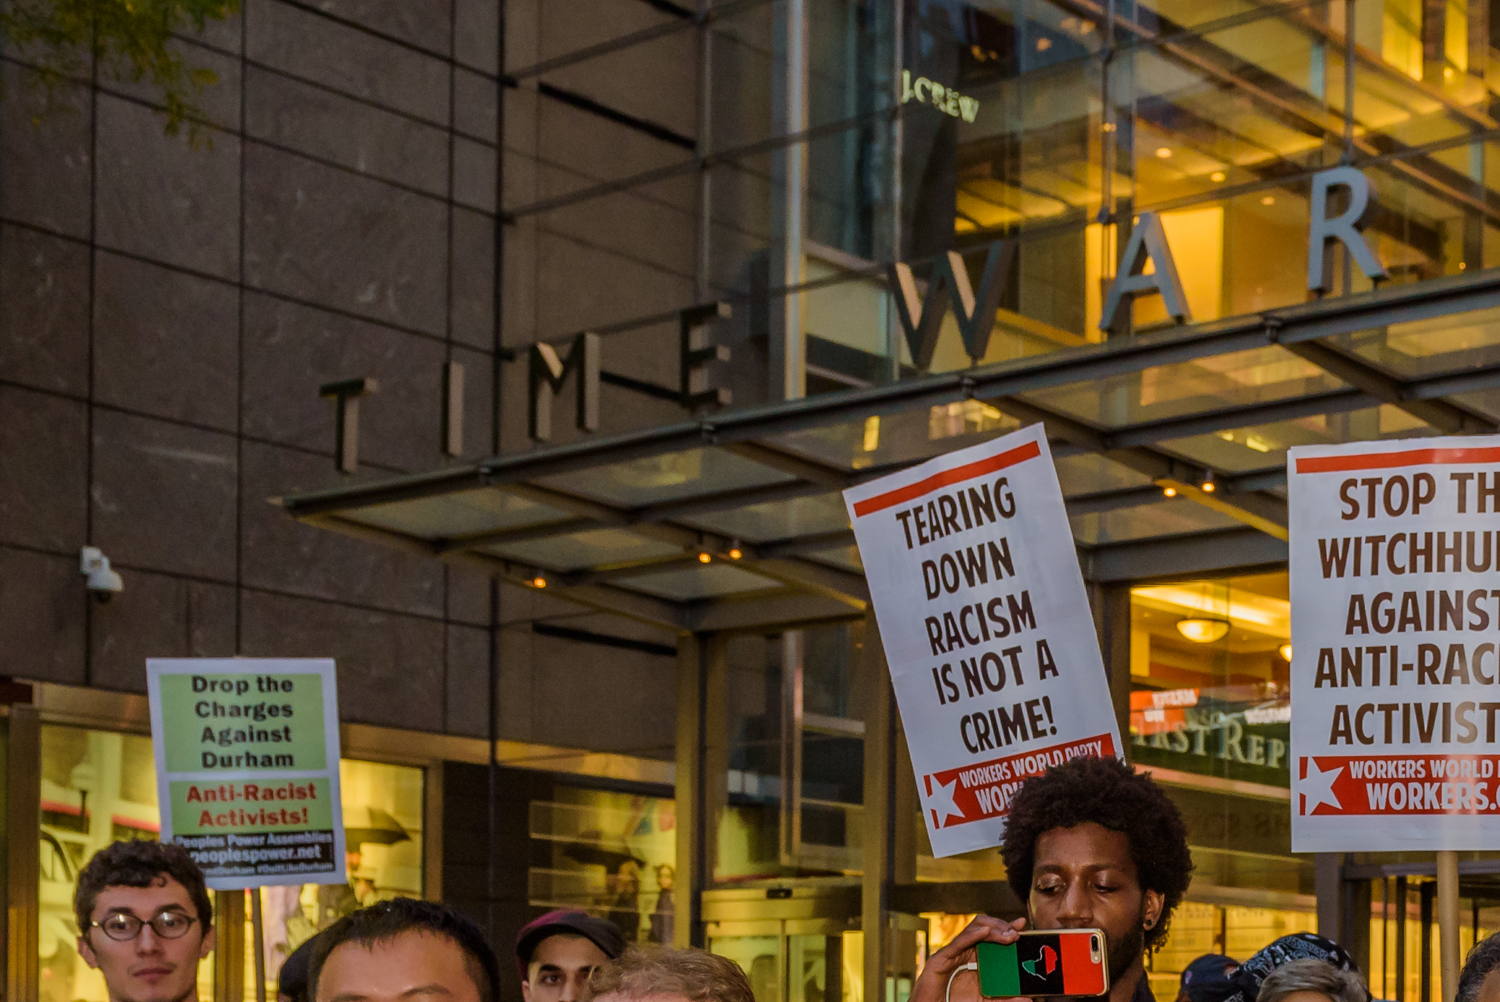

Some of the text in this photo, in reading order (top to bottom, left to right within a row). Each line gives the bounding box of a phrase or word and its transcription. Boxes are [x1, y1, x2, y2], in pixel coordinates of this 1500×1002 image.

[320, 301, 732, 475] TIME
[1339, 472, 1436, 520] STOP
[896, 477, 1016, 550] TEARING
[922, 537, 1015, 600] DOWN
[924, 590, 1037, 656] RACISM
[192, 676, 293, 695] Drop the
[931, 639, 1058, 704] IS NOT A
[195, 701, 293, 721] Charges
[960, 696, 1057, 754] CRIME!
[201, 725, 292, 747] Against
[202, 751, 294, 768] Durham
[959, 762, 1011, 788] WORKERS
[1011, 750, 1063, 777] WORLD
[1350, 759, 1426, 780] WORKERS
[1430, 759, 1494, 779] WORLD
[186, 782, 317, 803] Anti-Racist
[199, 808, 308, 827] Activists!
[228, 834, 265, 846] Power
